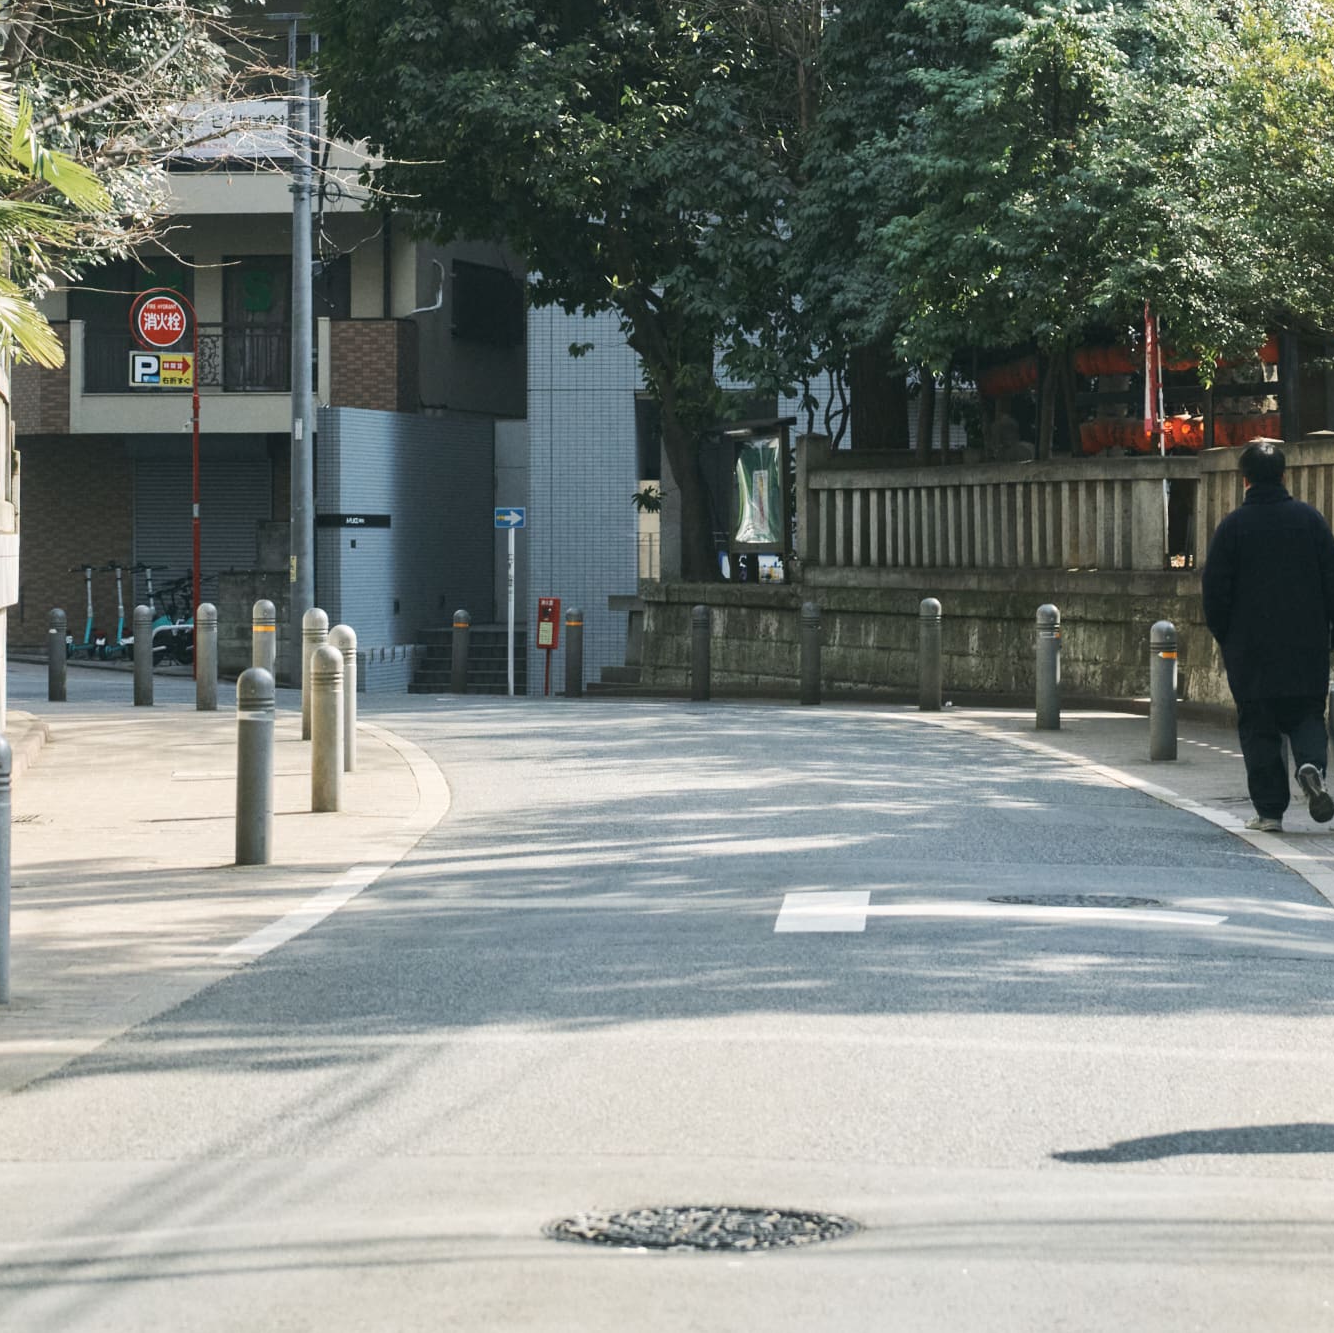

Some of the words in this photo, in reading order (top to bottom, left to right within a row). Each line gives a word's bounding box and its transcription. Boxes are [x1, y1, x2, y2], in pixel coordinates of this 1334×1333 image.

[143, 312, 181, 331] 消火栓
[134, 355, 159, 383] P
